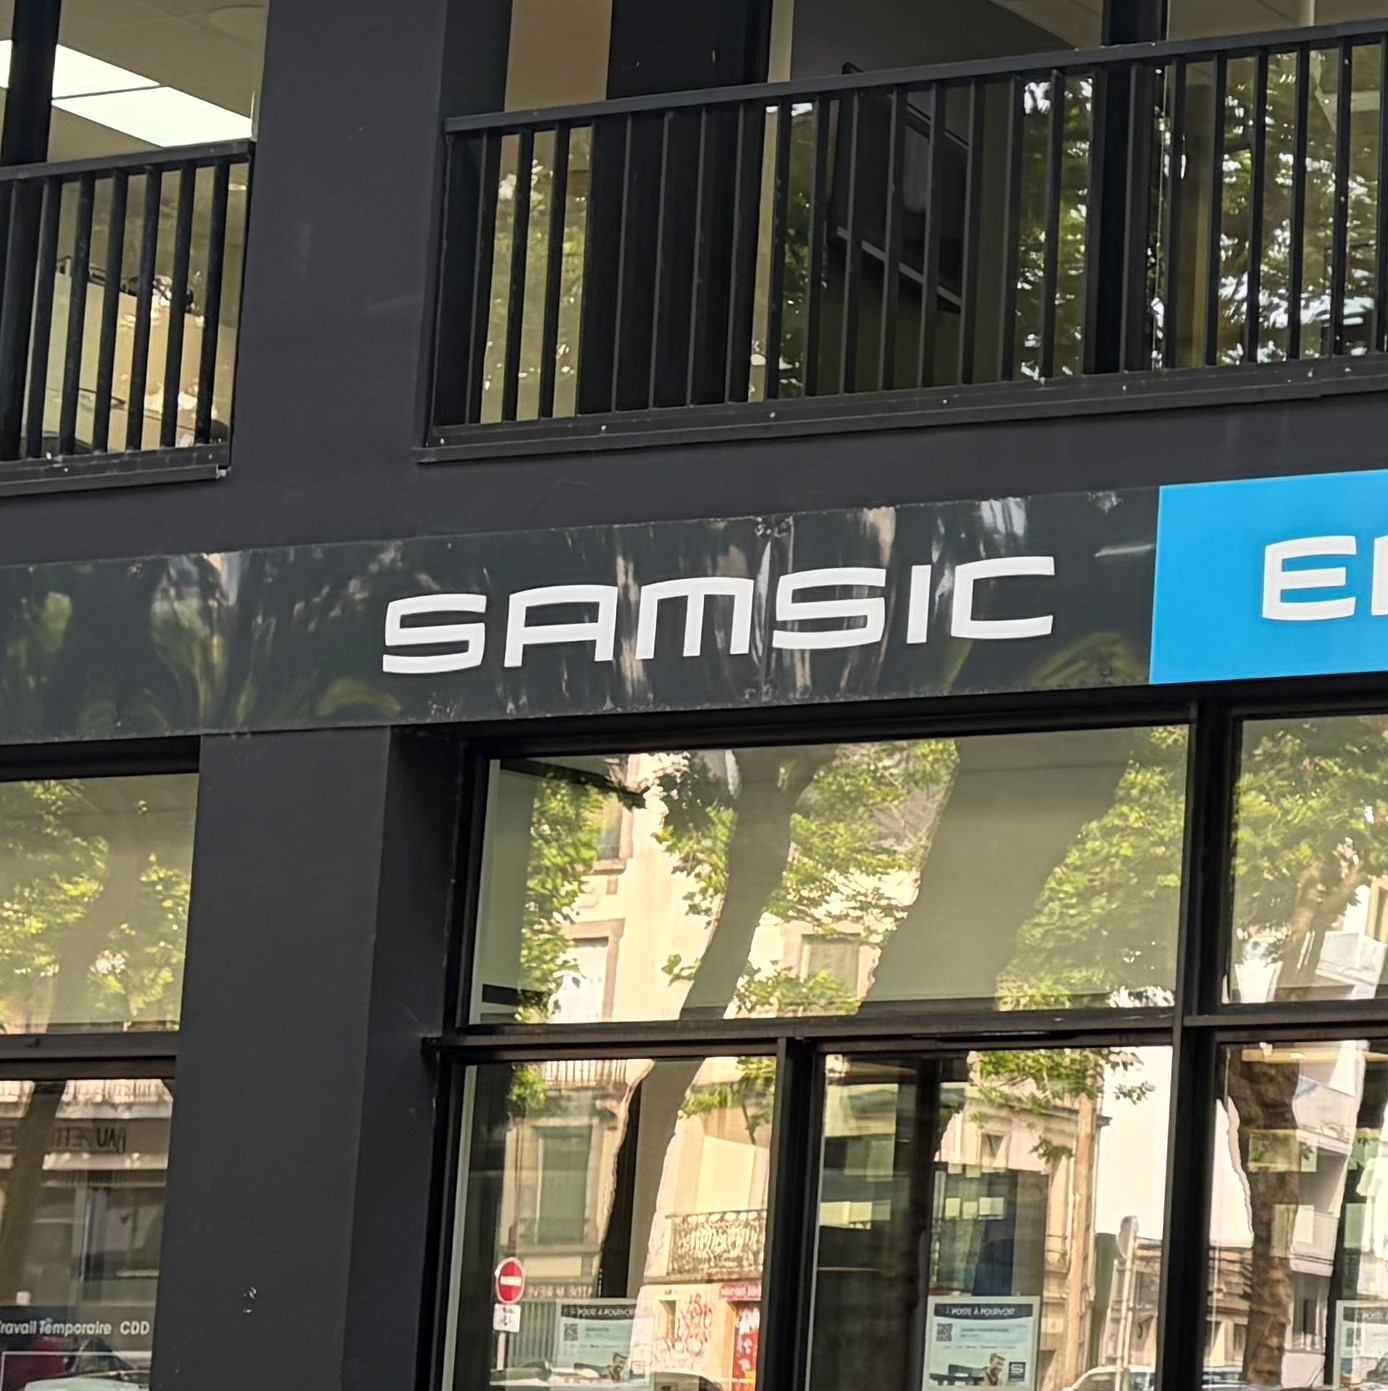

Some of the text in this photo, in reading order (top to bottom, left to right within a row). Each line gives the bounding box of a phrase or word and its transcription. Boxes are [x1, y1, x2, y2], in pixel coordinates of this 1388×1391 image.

[382, 556, 1055, 674] SAMSIC
[0, 1319, 150, 1337] ravail Temporaire CDD
